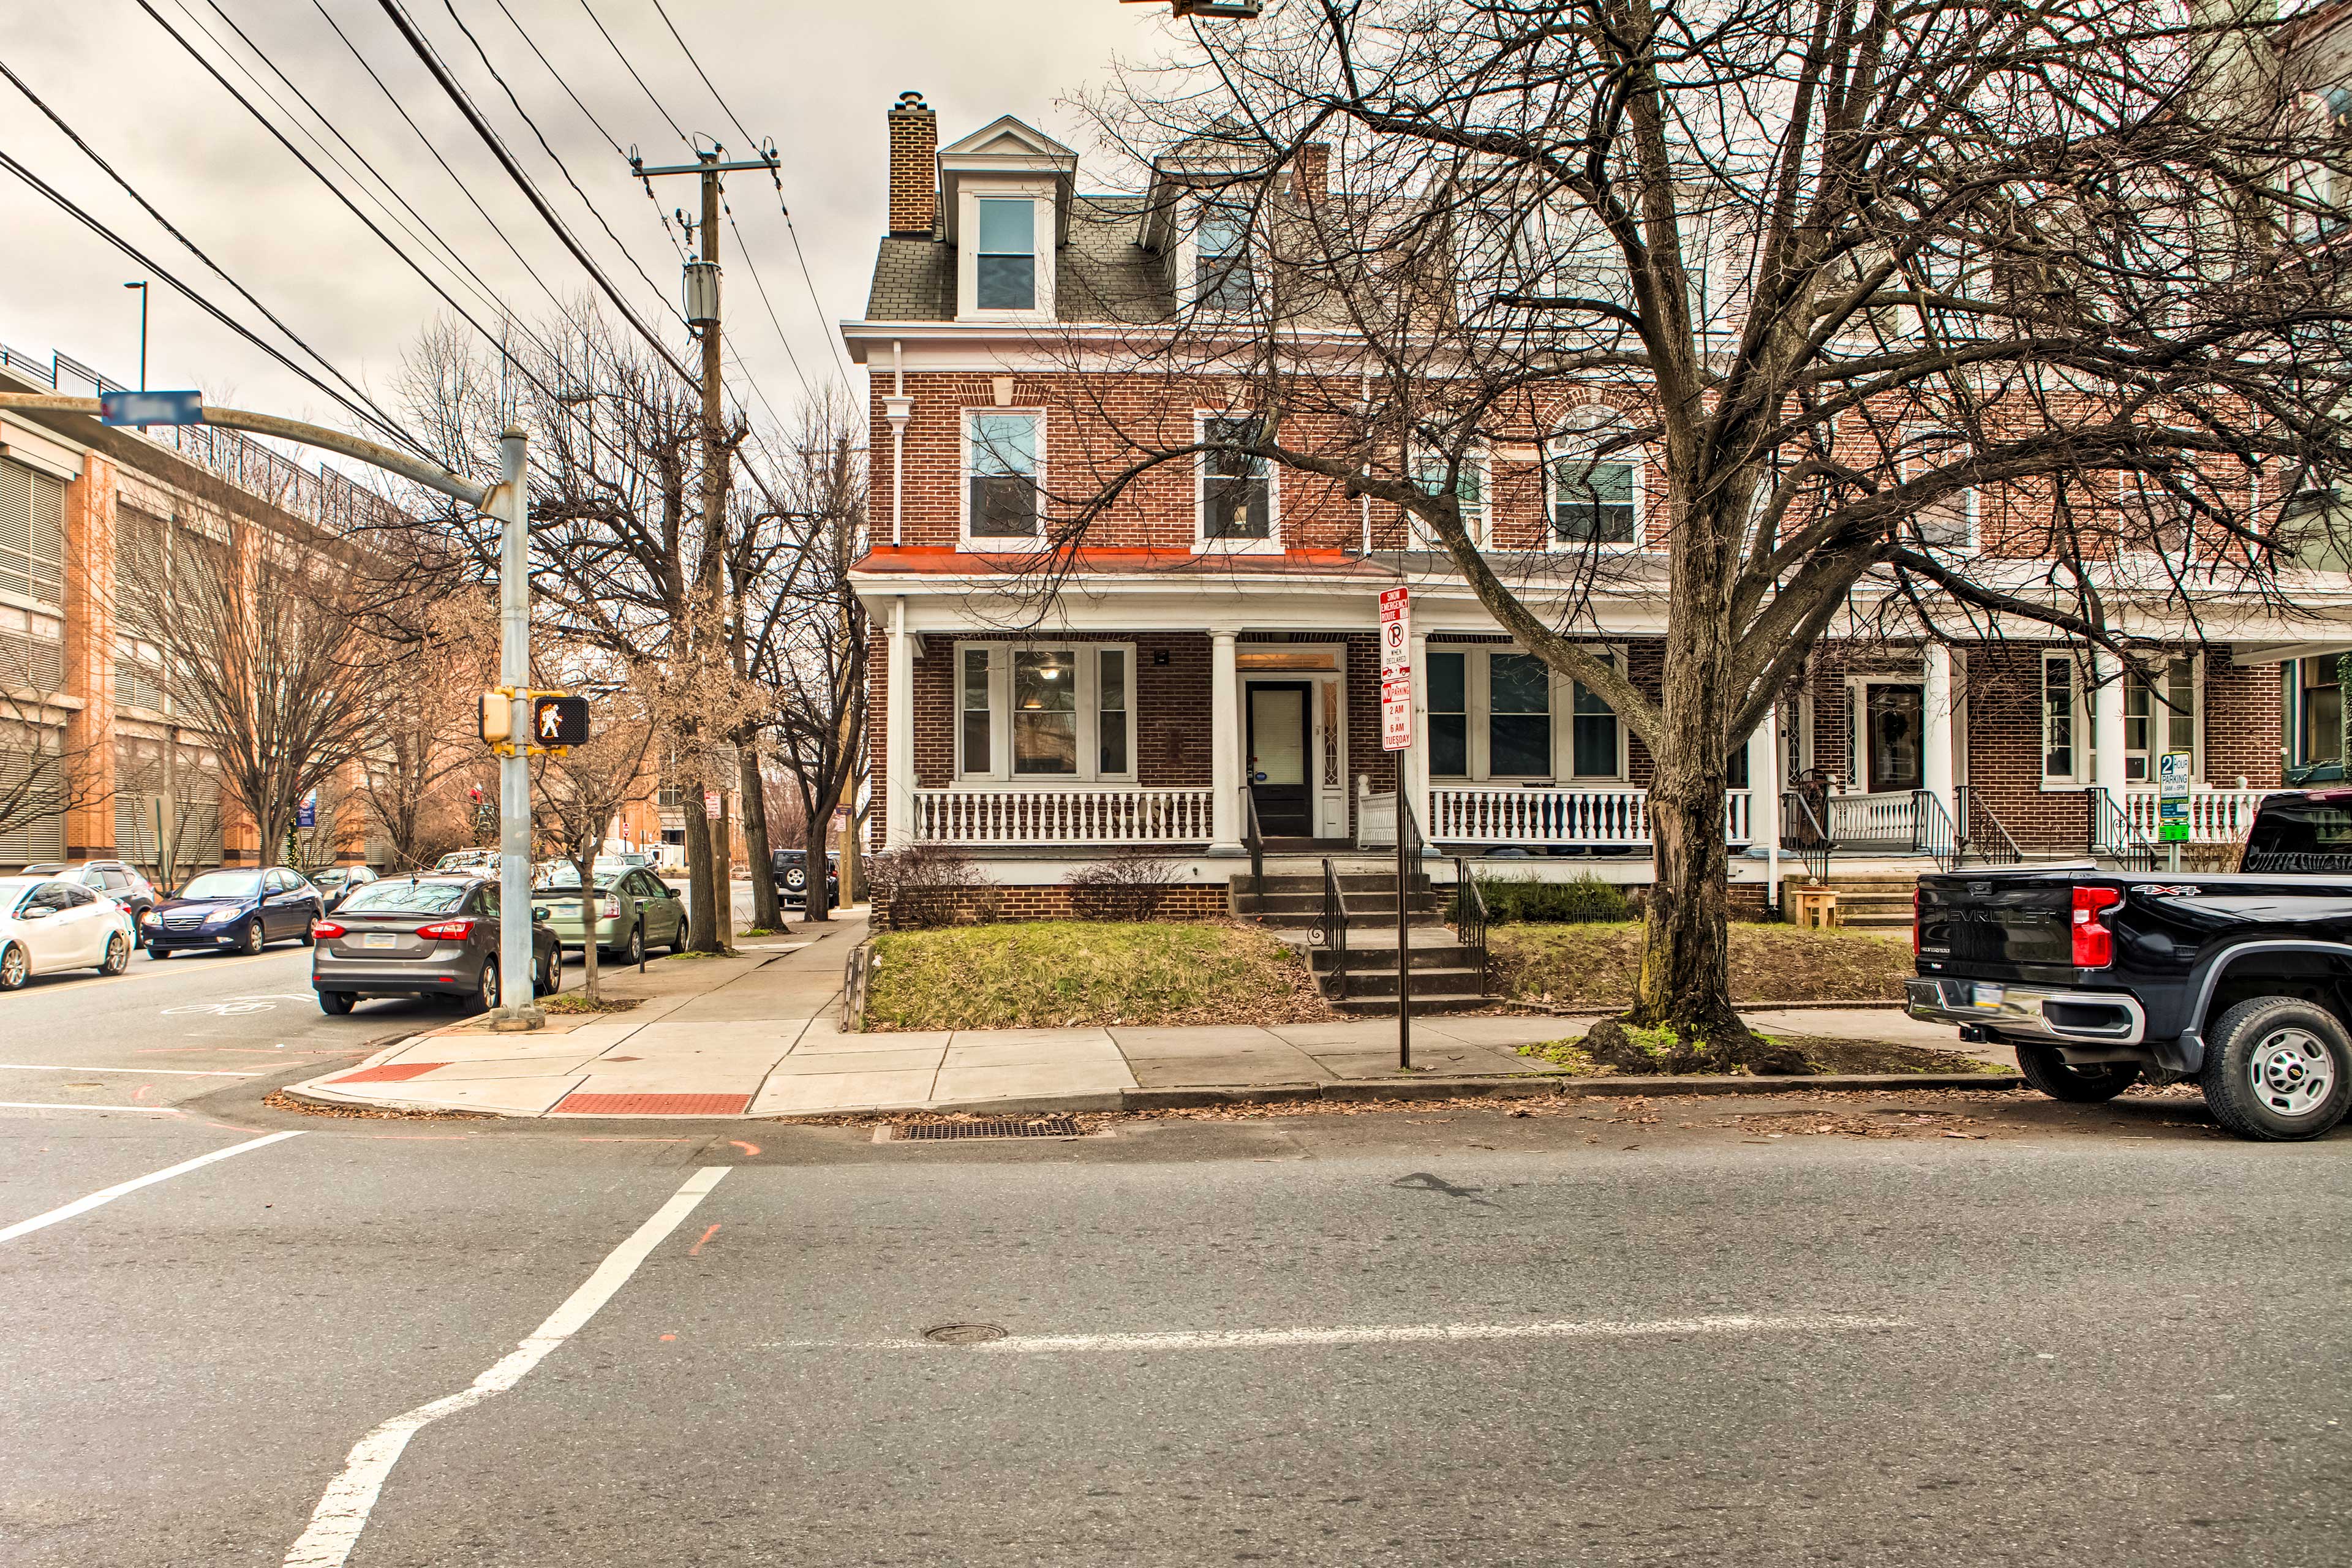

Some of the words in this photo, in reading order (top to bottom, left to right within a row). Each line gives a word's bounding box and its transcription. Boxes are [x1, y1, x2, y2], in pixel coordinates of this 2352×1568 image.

[1387, 590, 1400, 601] SNOW
[1381, 598, 1408, 612] EMERGENCY
[1382, 611, 1396, 621] ROUTE
[1383, 687, 1391, 699] NO
[1392, 686, 1409, 696] PARKING
[1395, 705, 1404, 714] AM
[1395, 723, 1404, 732] AM
[1385, 734, 1409, 745] TUESDAY
[2162, 755, 2172, 774] 2
[2174, 760, 2188, 769] HOUR
[2162, 774, 2187, 784] PARKING
[1924, 908, 2056, 924] CHEVROLET
